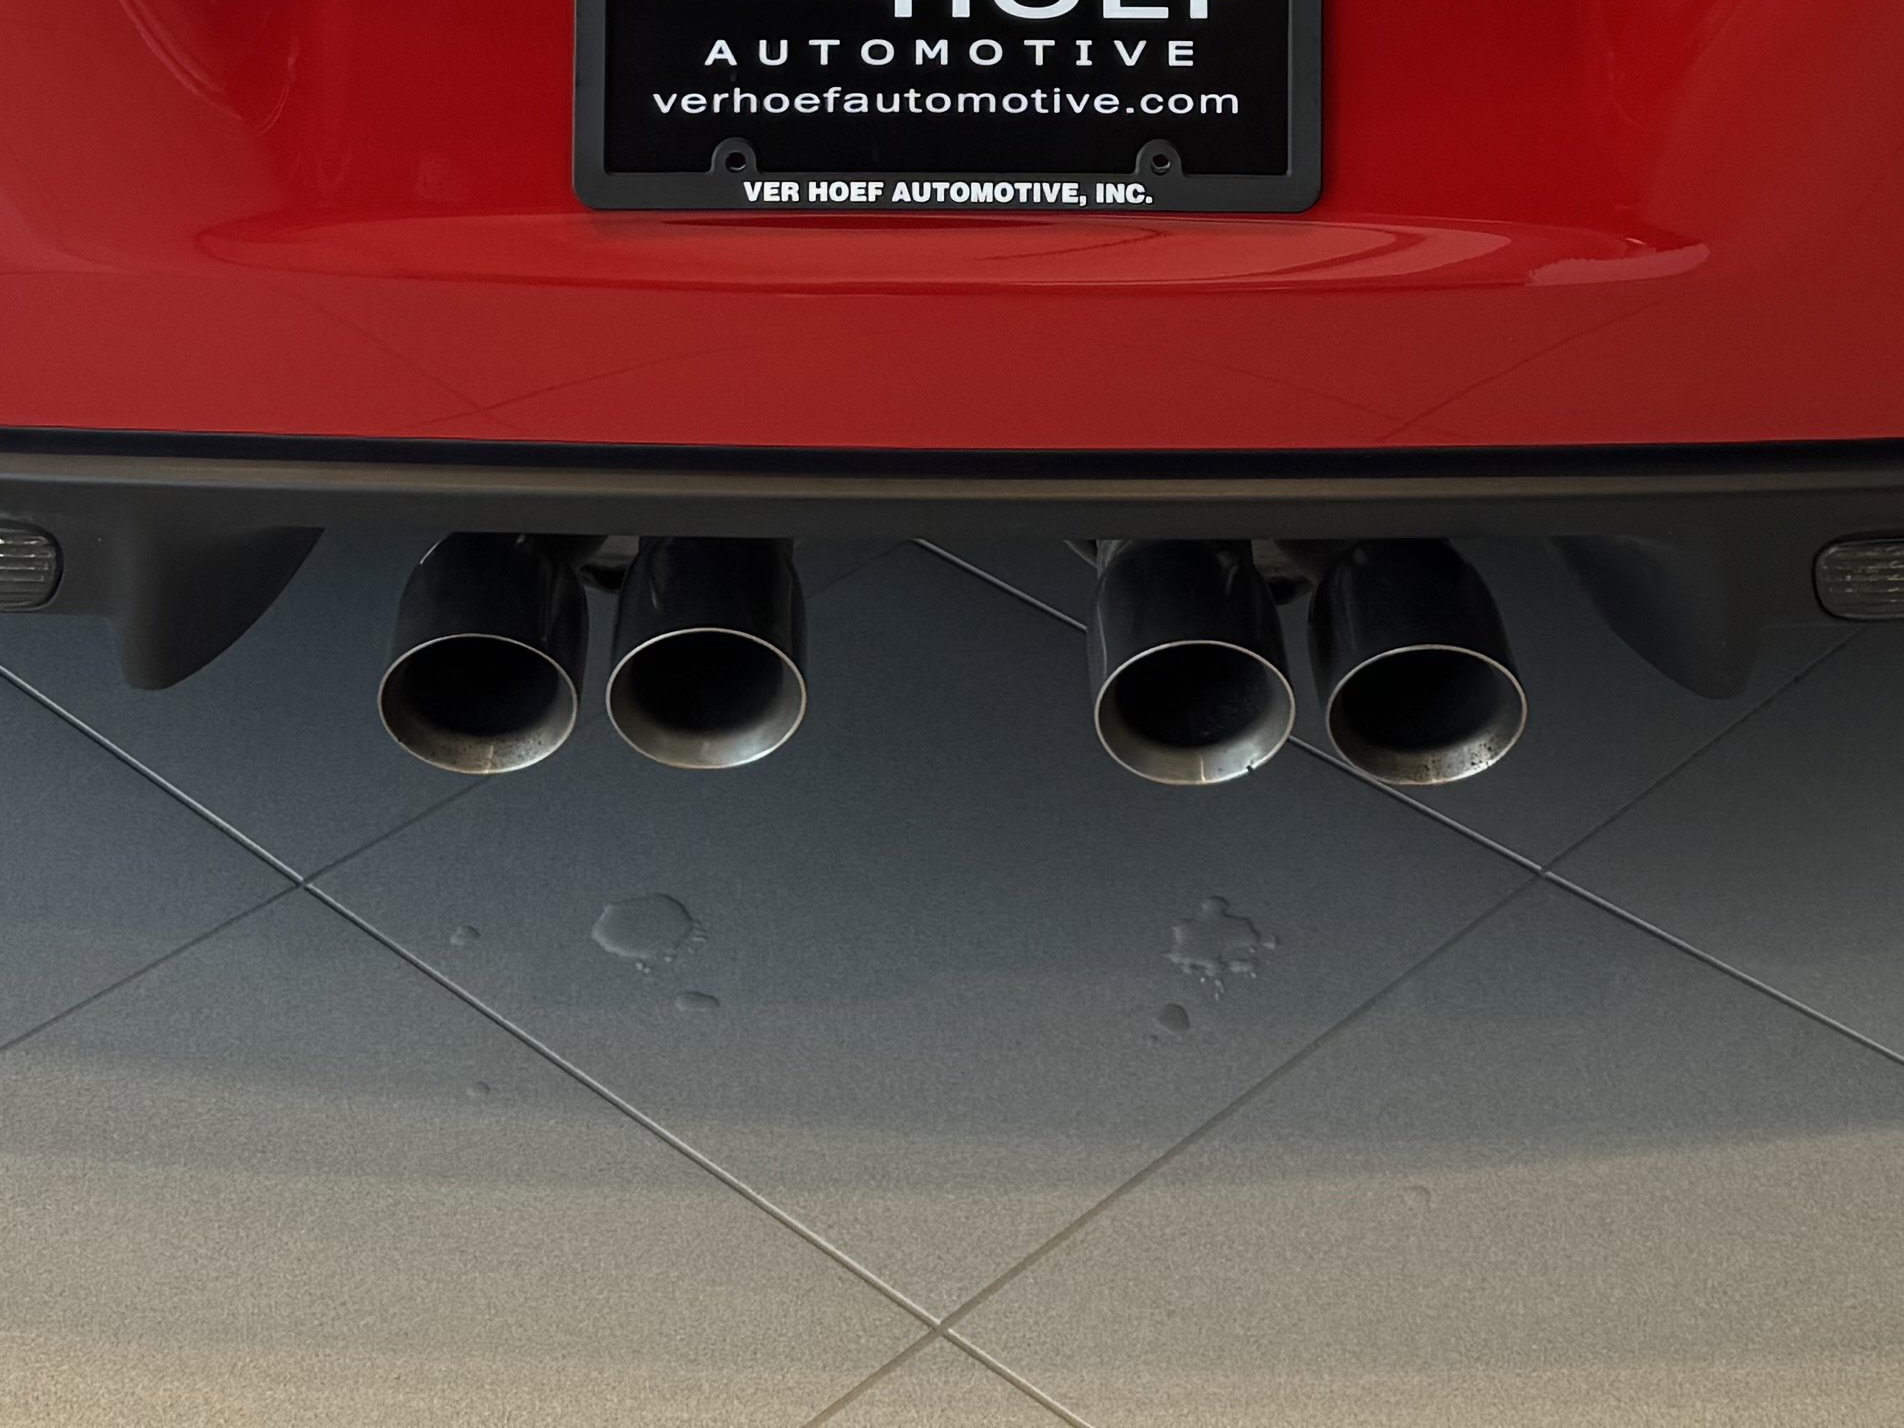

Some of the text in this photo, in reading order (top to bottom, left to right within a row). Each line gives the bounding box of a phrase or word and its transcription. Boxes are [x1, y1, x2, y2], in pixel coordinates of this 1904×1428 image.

[704, 38, 1194, 67] AUTOMOTIVE
[652, 86, 1239, 114] verhoefautomotive.com
[743, 181, 1153, 207] VER HOEF AUTOMOTIVE, INC.
